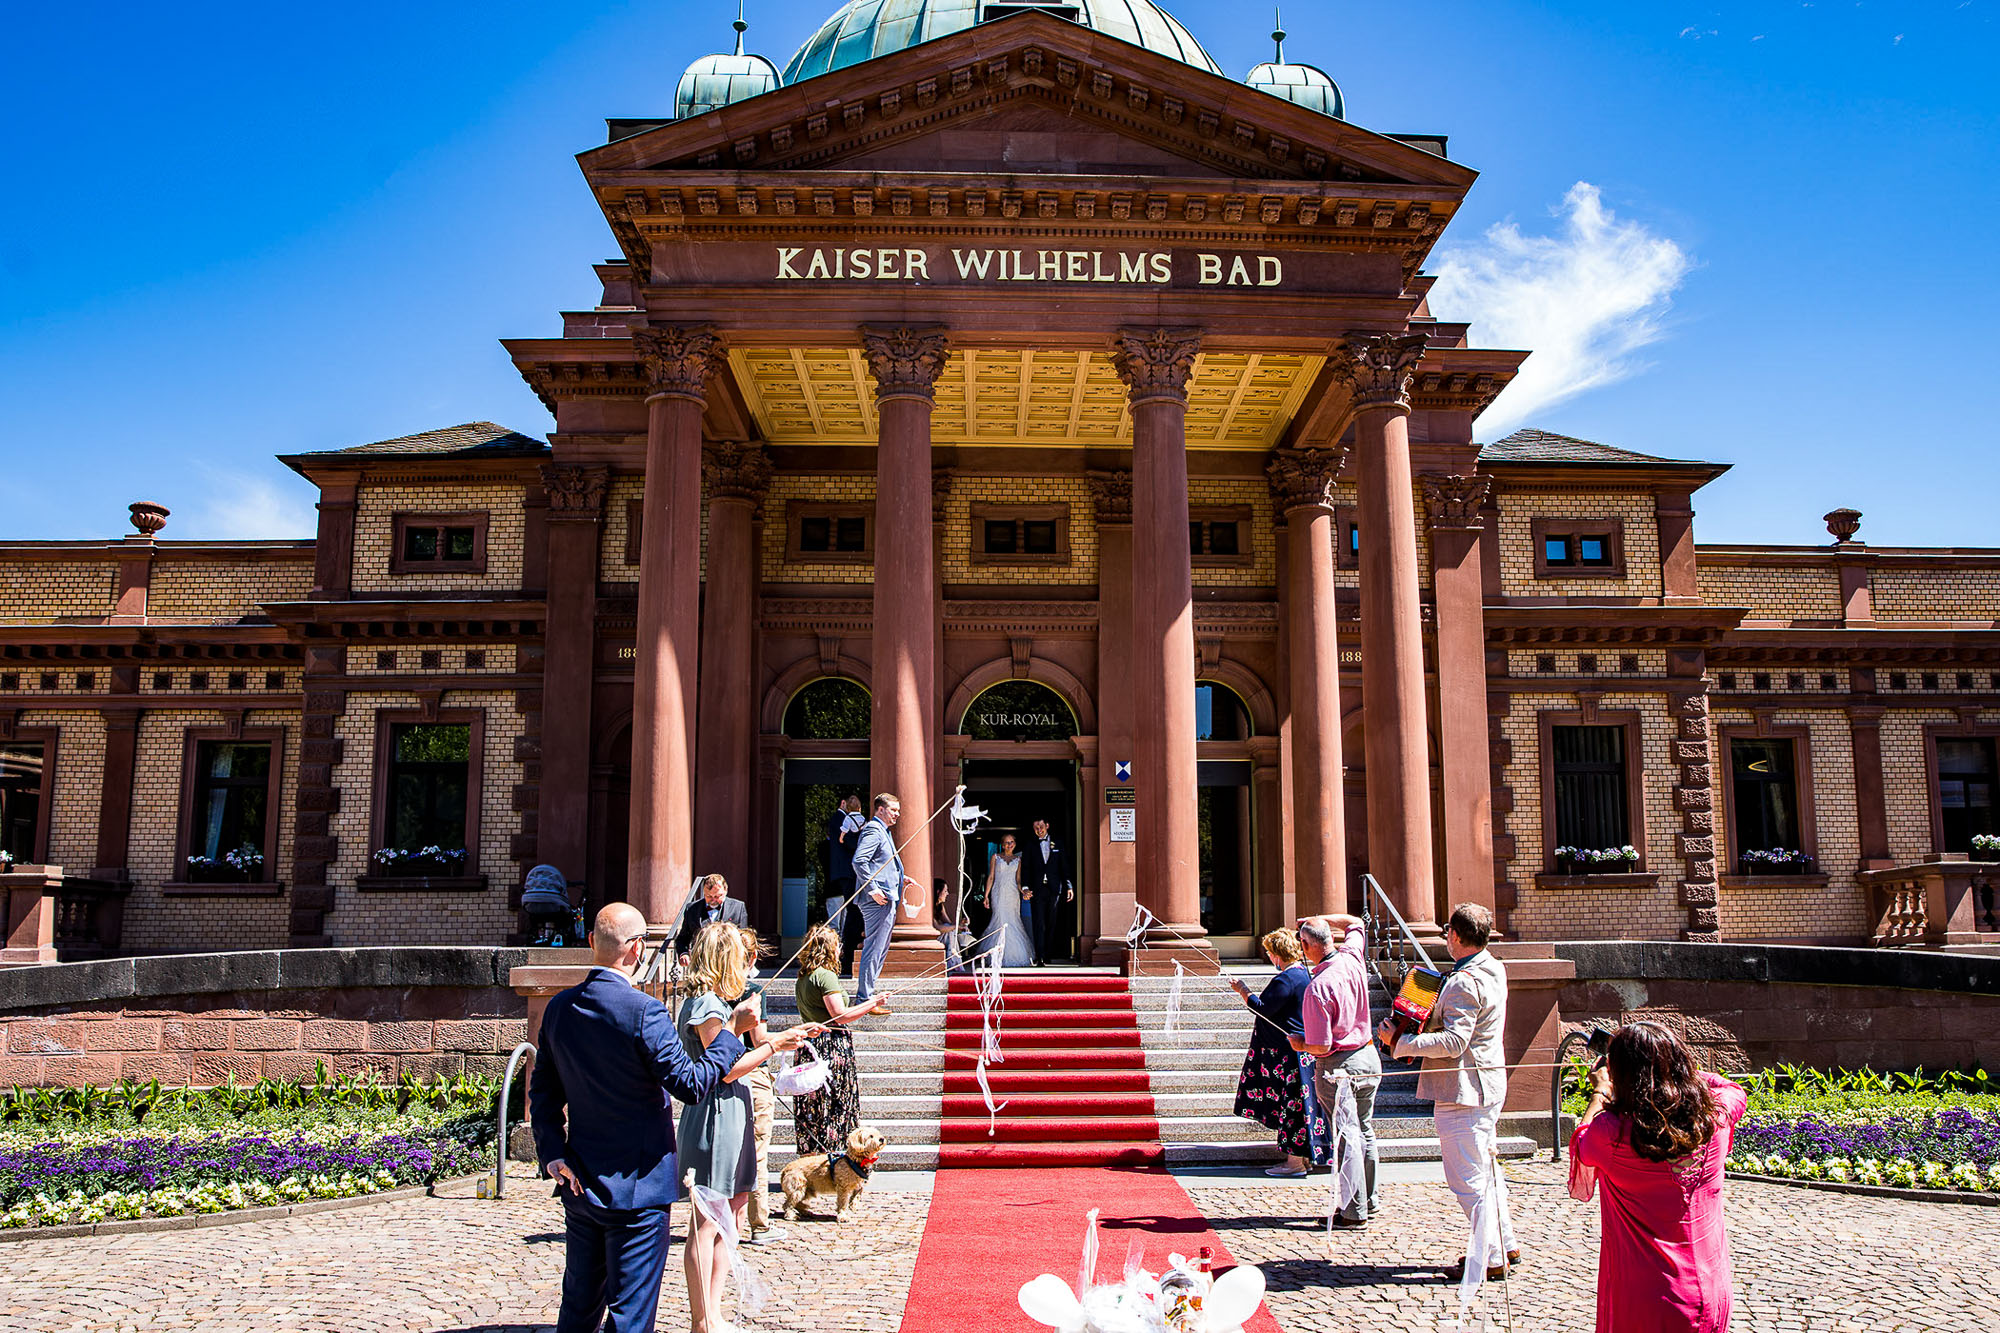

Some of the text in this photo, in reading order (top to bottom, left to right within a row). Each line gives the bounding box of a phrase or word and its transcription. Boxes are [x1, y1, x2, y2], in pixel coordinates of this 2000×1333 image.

[775, 247, 1283, 286] KAISER WILHELMS BAD
[979, 713, 1060, 726] KUR-ROYAL
